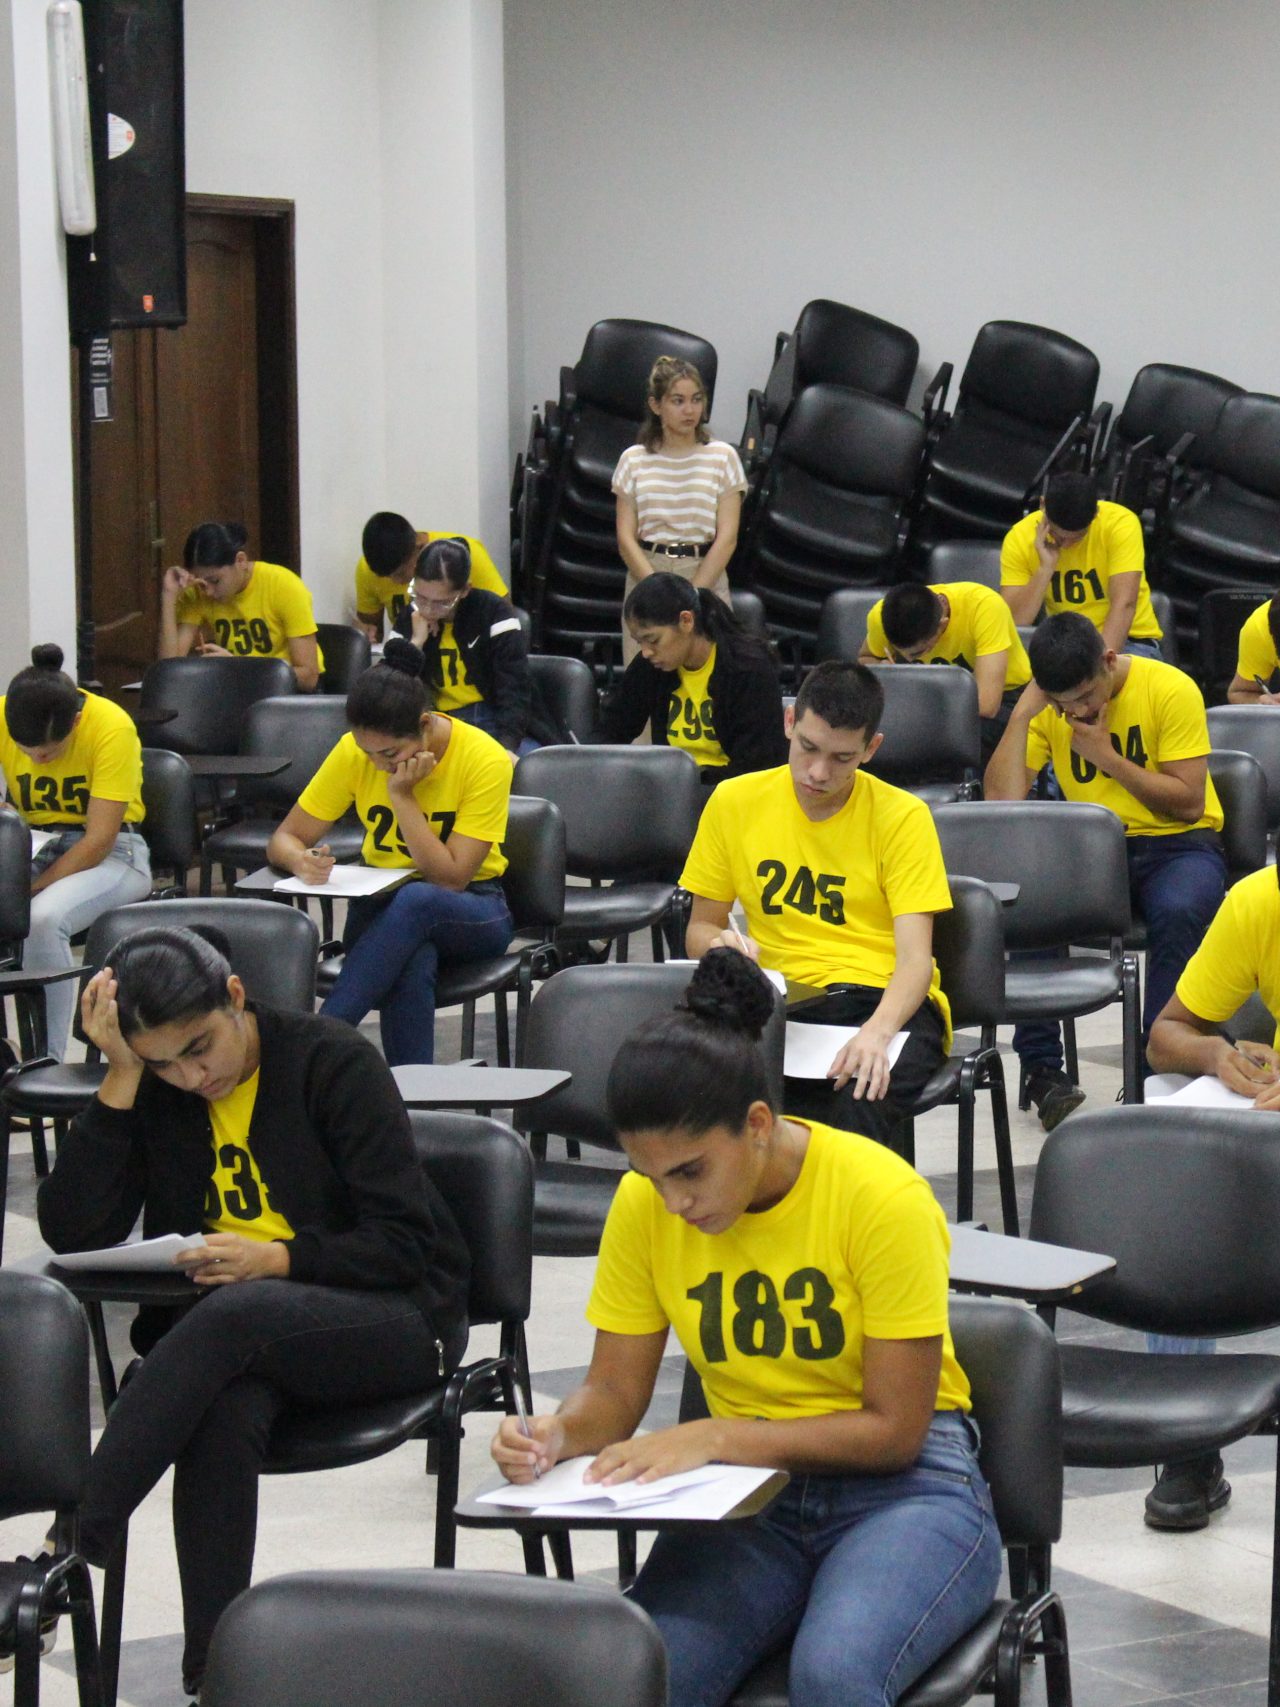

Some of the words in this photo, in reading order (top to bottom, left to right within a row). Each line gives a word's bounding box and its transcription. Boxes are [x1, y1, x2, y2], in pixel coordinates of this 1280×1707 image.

[1051, 568, 1105, 605] 161
[215, 617, 273, 655] 259
[15, 772, 91, 816] 135
[756, 858, 847, 926] 245
[685, 1265, 846, 1364] 183
